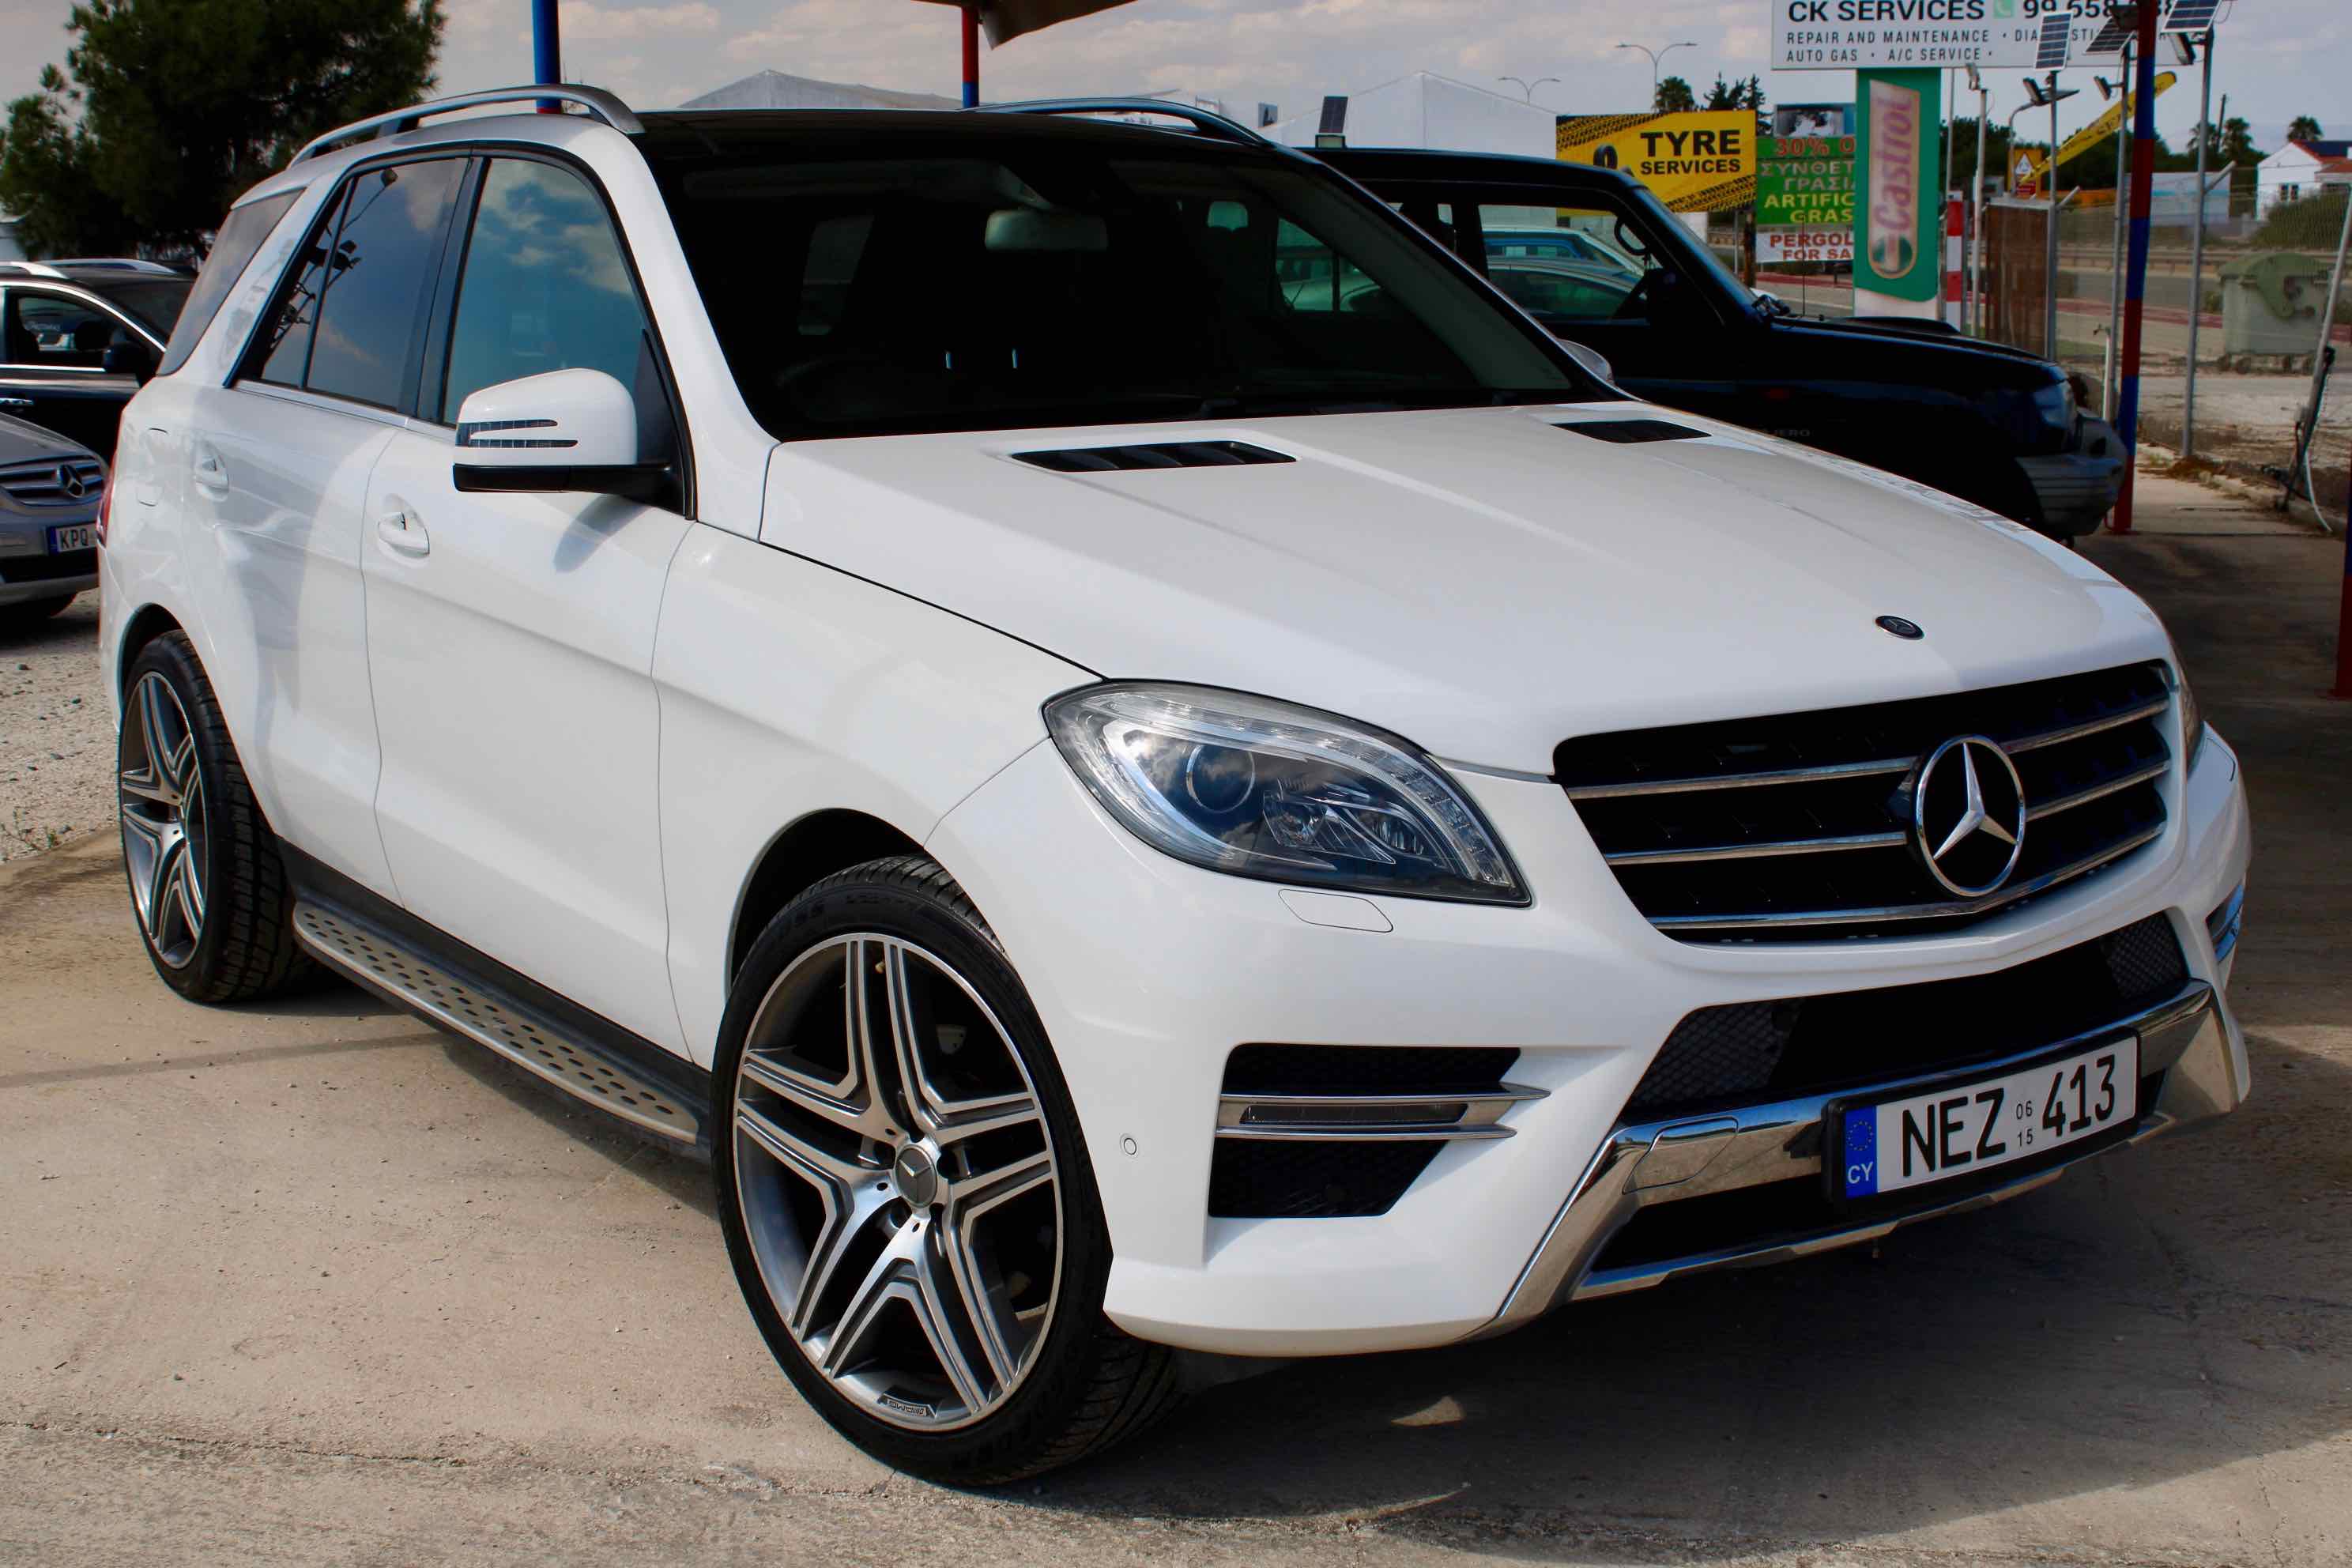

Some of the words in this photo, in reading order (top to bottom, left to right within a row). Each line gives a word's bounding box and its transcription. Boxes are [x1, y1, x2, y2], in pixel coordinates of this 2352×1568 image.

[1788, 0, 1828, 22] CK
[1838, 0, 1985, 21] SERVICES
[1787, 31, 1840, 44] REPAIR
[1846, 31, 1875, 43] AND
[1883, 29, 1989, 43] MAINTENANCE
[1786, 49, 1823, 62] AUTO
[1831, 48, 1858, 61] GAS
[1888, 47, 1913, 61] A/C
[1920, 47, 1981, 60] SERVICE
[1640, 130, 1741, 157] TYRE
[1775, 138, 1830, 156] 30%
[1640, 158, 1741, 175] SERVICES
[1872, 96, 1912, 231] Castrol
[1764, 191, 1856, 209] ARTIFIC
[1789, 209, 1853, 224] GRAS
[1783, 249, 1820, 261] FOR
[1827, 248, 1851, 260] SA
[1902, 1087, 2007, 1177] NEZ
[2042, 1054, 2116, 1137] 413
[2016, 1100, 2033, 1120] 06
[2017, 1128, 2034, 1147] 15
[1847, 1161, 1875, 1185] CY
